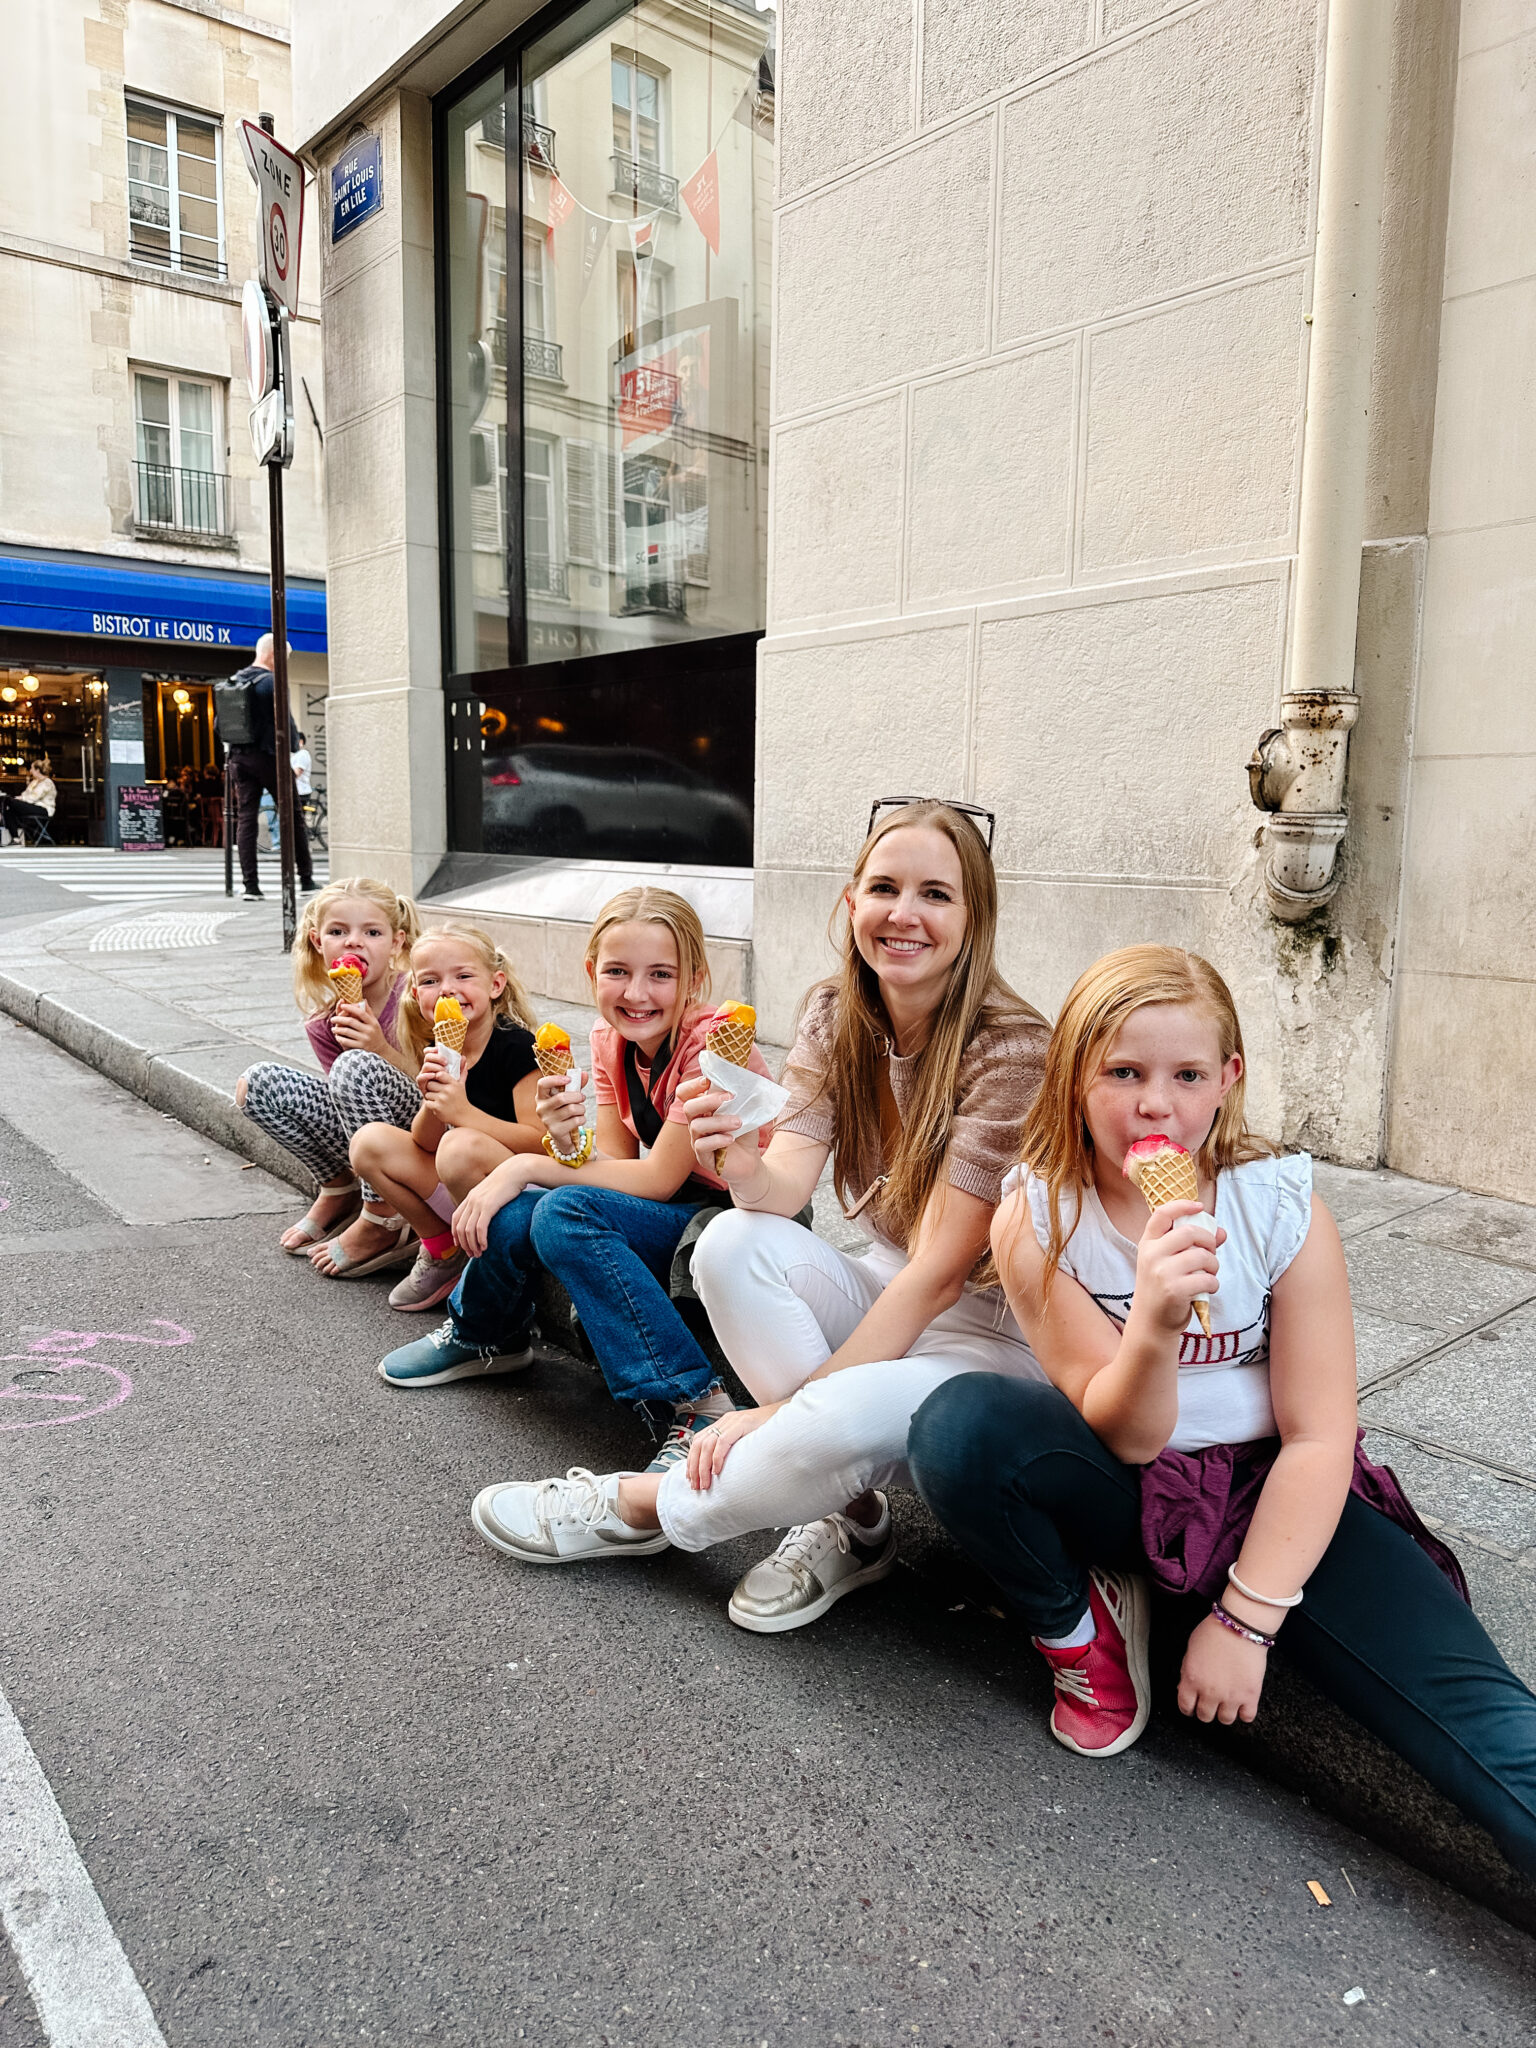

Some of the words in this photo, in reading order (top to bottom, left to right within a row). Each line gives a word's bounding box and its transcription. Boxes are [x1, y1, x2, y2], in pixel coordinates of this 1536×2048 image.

[260, 149, 292, 198] ZONE
[344, 157, 359, 178] RUE
[333, 180, 351, 205] SAINT
[351, 165, 374, 190] LOUIS
[340, 198, 351, 217] EN
[554, 193, 567, 209] 51
[273, 224, 285, 260] 30
[635, 370, 651, 396] 51
[92, 613, 151, 637] BISTROT
[155, 621, 170, 638] LE
[173, 621, 215, 643] LOUIS
[218, 627, 231, 644] IX
